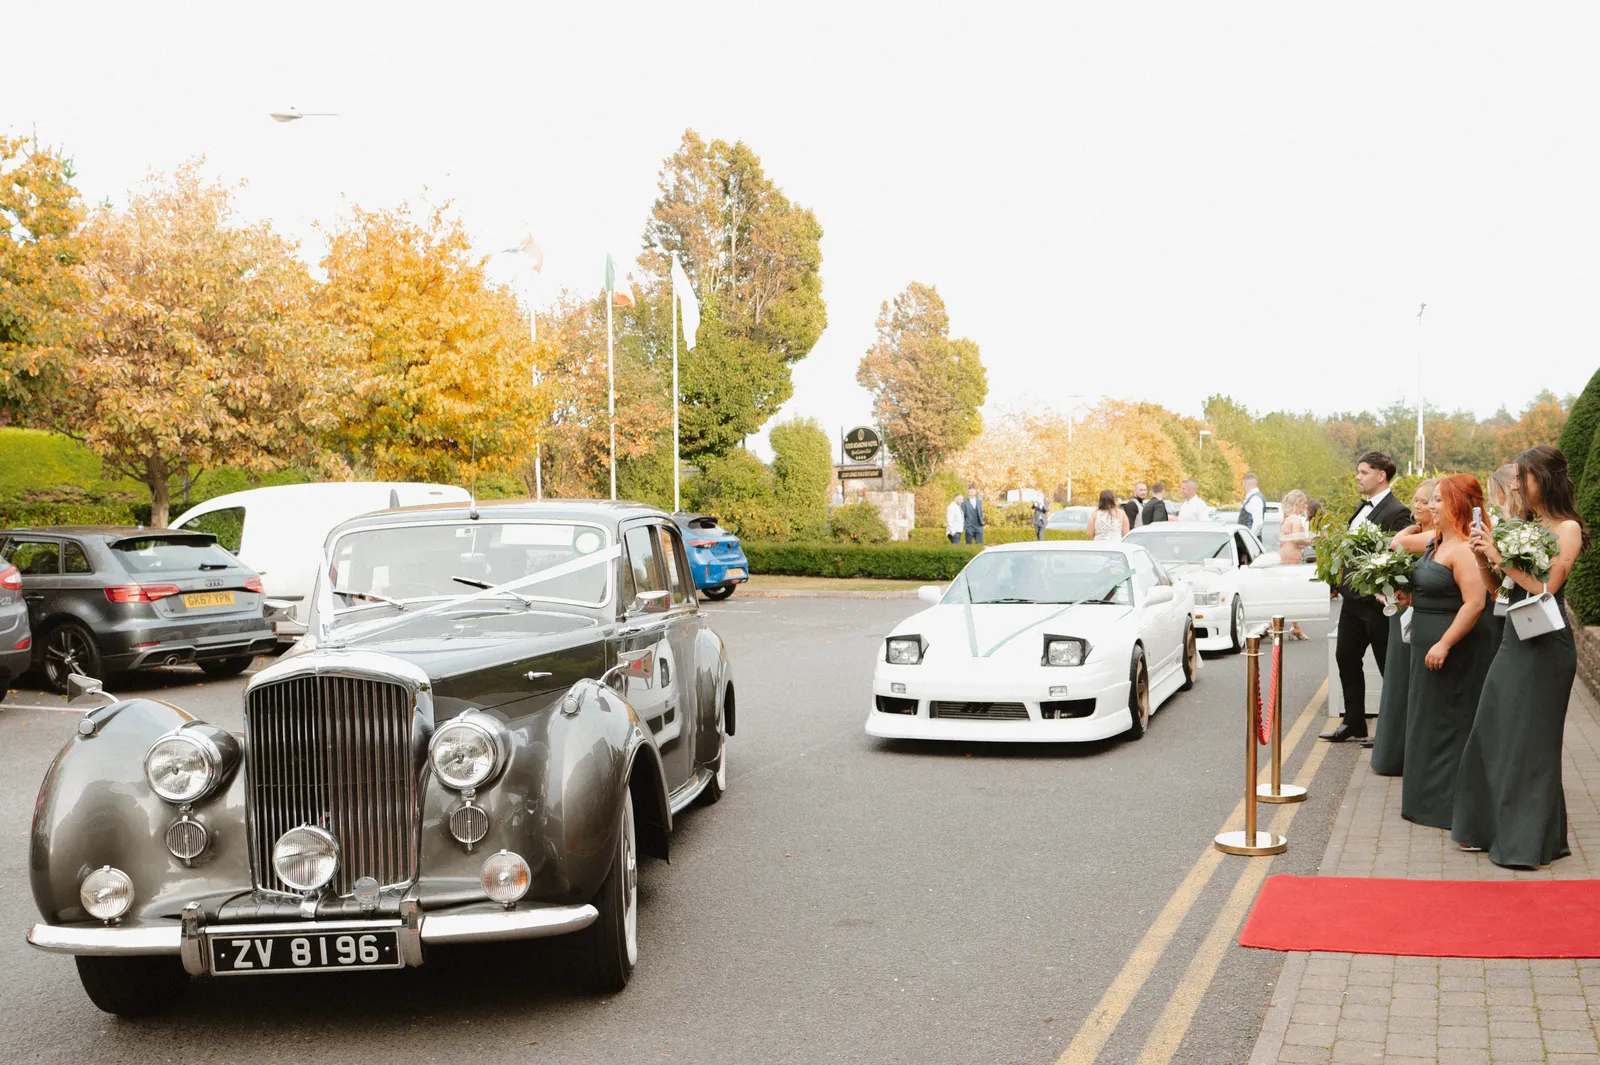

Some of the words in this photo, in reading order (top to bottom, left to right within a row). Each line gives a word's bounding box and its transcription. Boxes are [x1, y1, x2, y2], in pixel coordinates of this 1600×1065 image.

[187, 594, 212, 606] GK67
[213, 592, 231, 604] YPN
[231, 939, 273, 969] ZV
[290, 934, 380, 966] 8196
